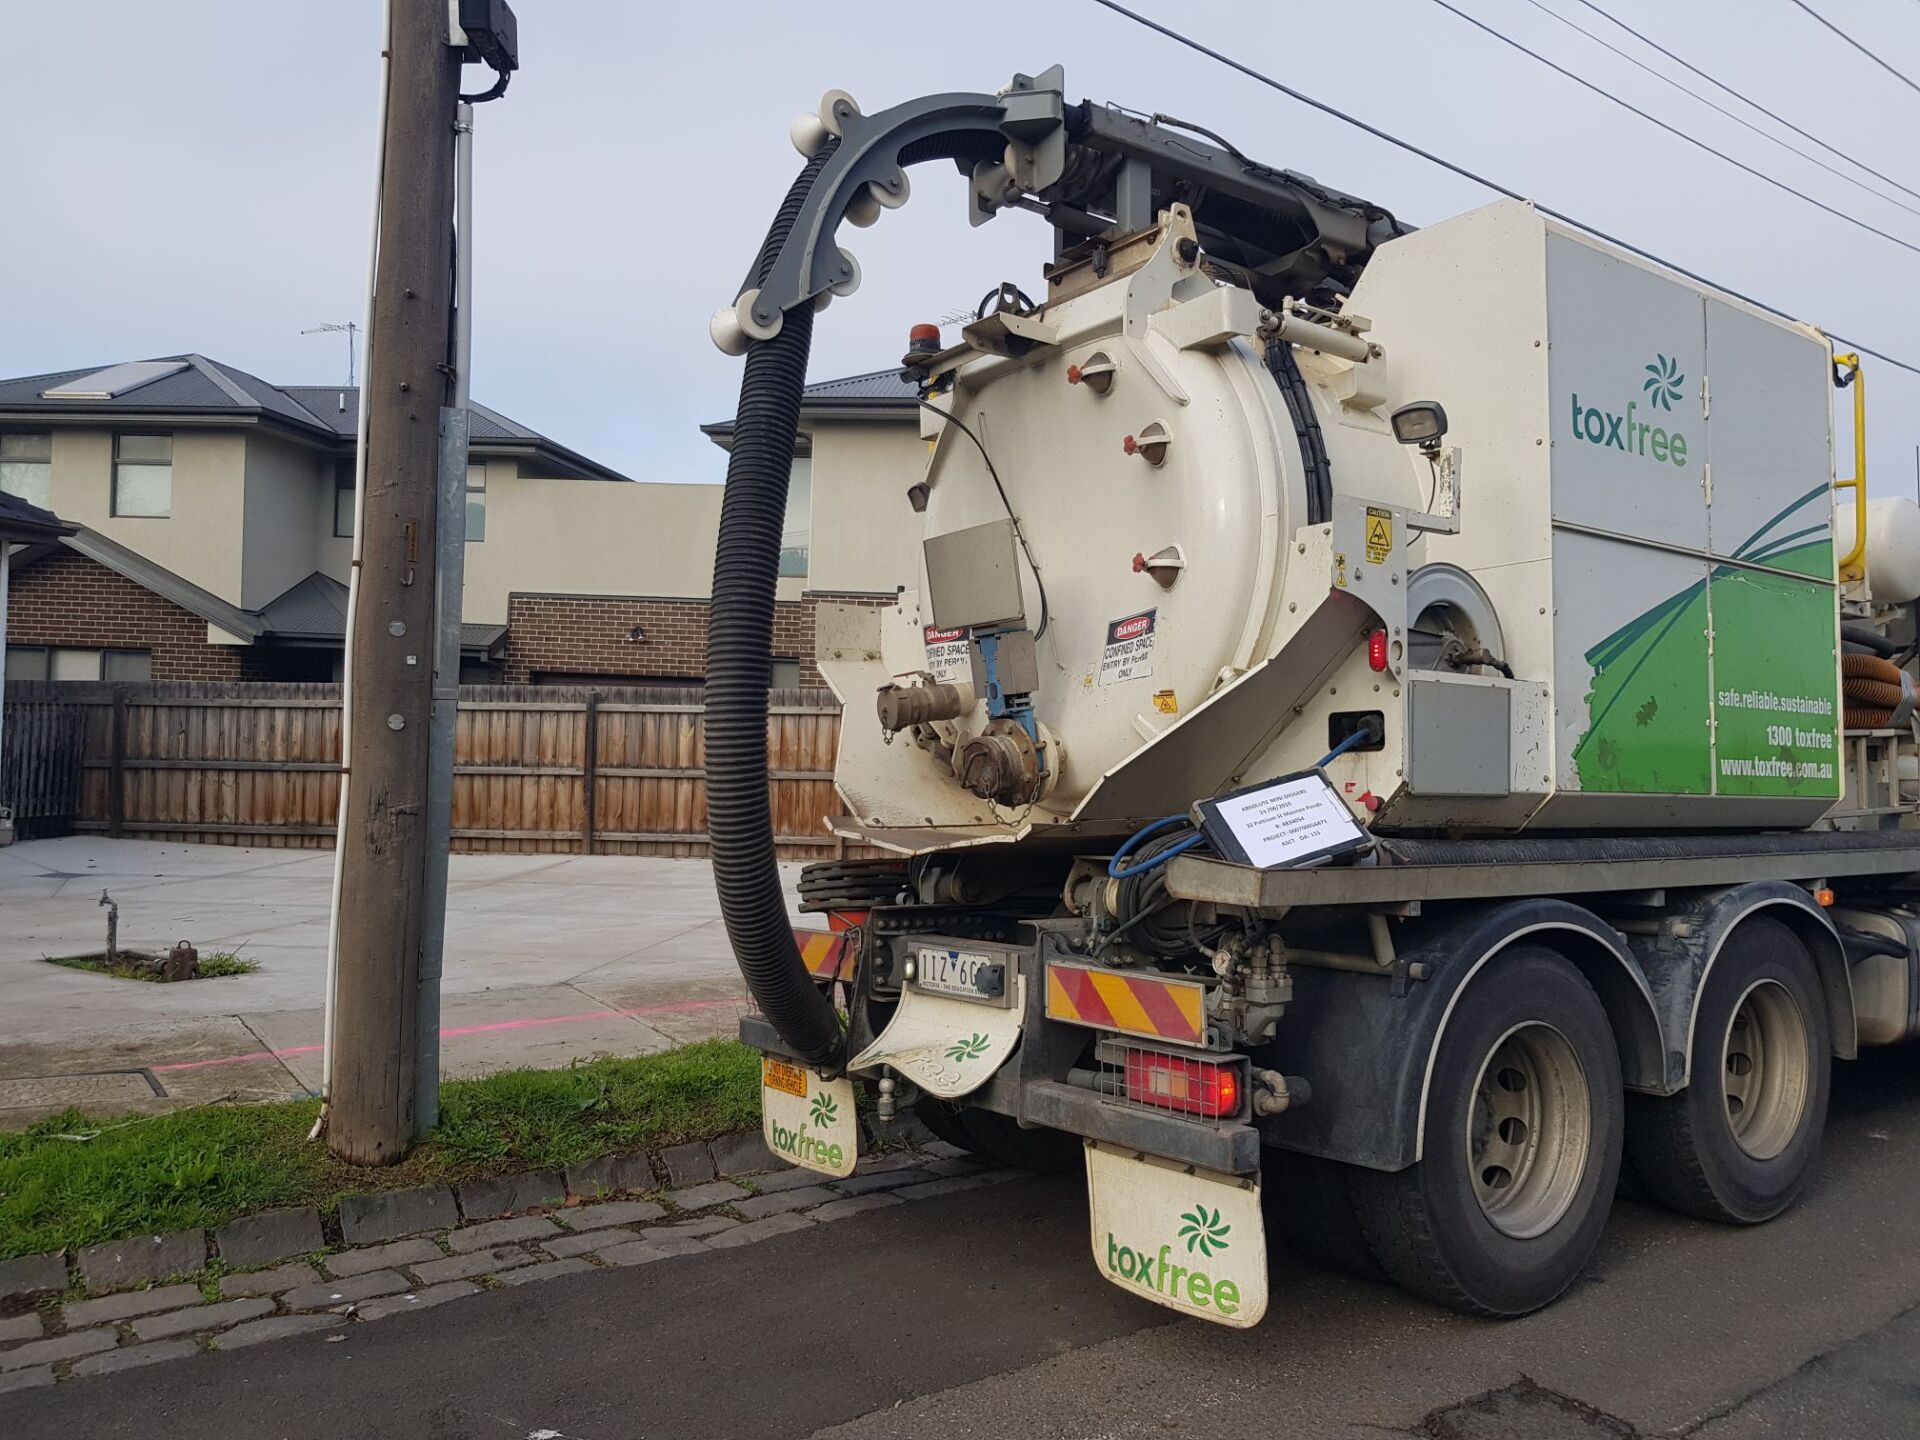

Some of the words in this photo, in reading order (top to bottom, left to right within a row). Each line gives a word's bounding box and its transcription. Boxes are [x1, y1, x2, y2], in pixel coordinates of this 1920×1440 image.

[1571, 392, 1688, 468] toxfree
[1117, 620, 1147, 636] DANGER
[947, 644, 970, 656] SPACE
[1105, 642, 1134, 659] CONFINED
[1135, 636, 1153, 651] SPACE
[1102, 658, 1122, 671] ENTRY
[1122, 656, 1130, 667] BY
[1118, 667, 1133, 679] ONLY
[1718, 688, 1832, 715] safe.reliable.sustainable
[1766, 725, 1792, 747] 1300
[1795, 728, 1832, 749] toxfree
[1720, 756, 1833, 779] www.toxfree.com.au
[1241, 800, 1269, 812] ABSOLUTE
[960, 960, 987, 987] 6G
[772, 1119, 843, 1168] toxfree
[1107, 1231, 1241, 1314] toxfree
